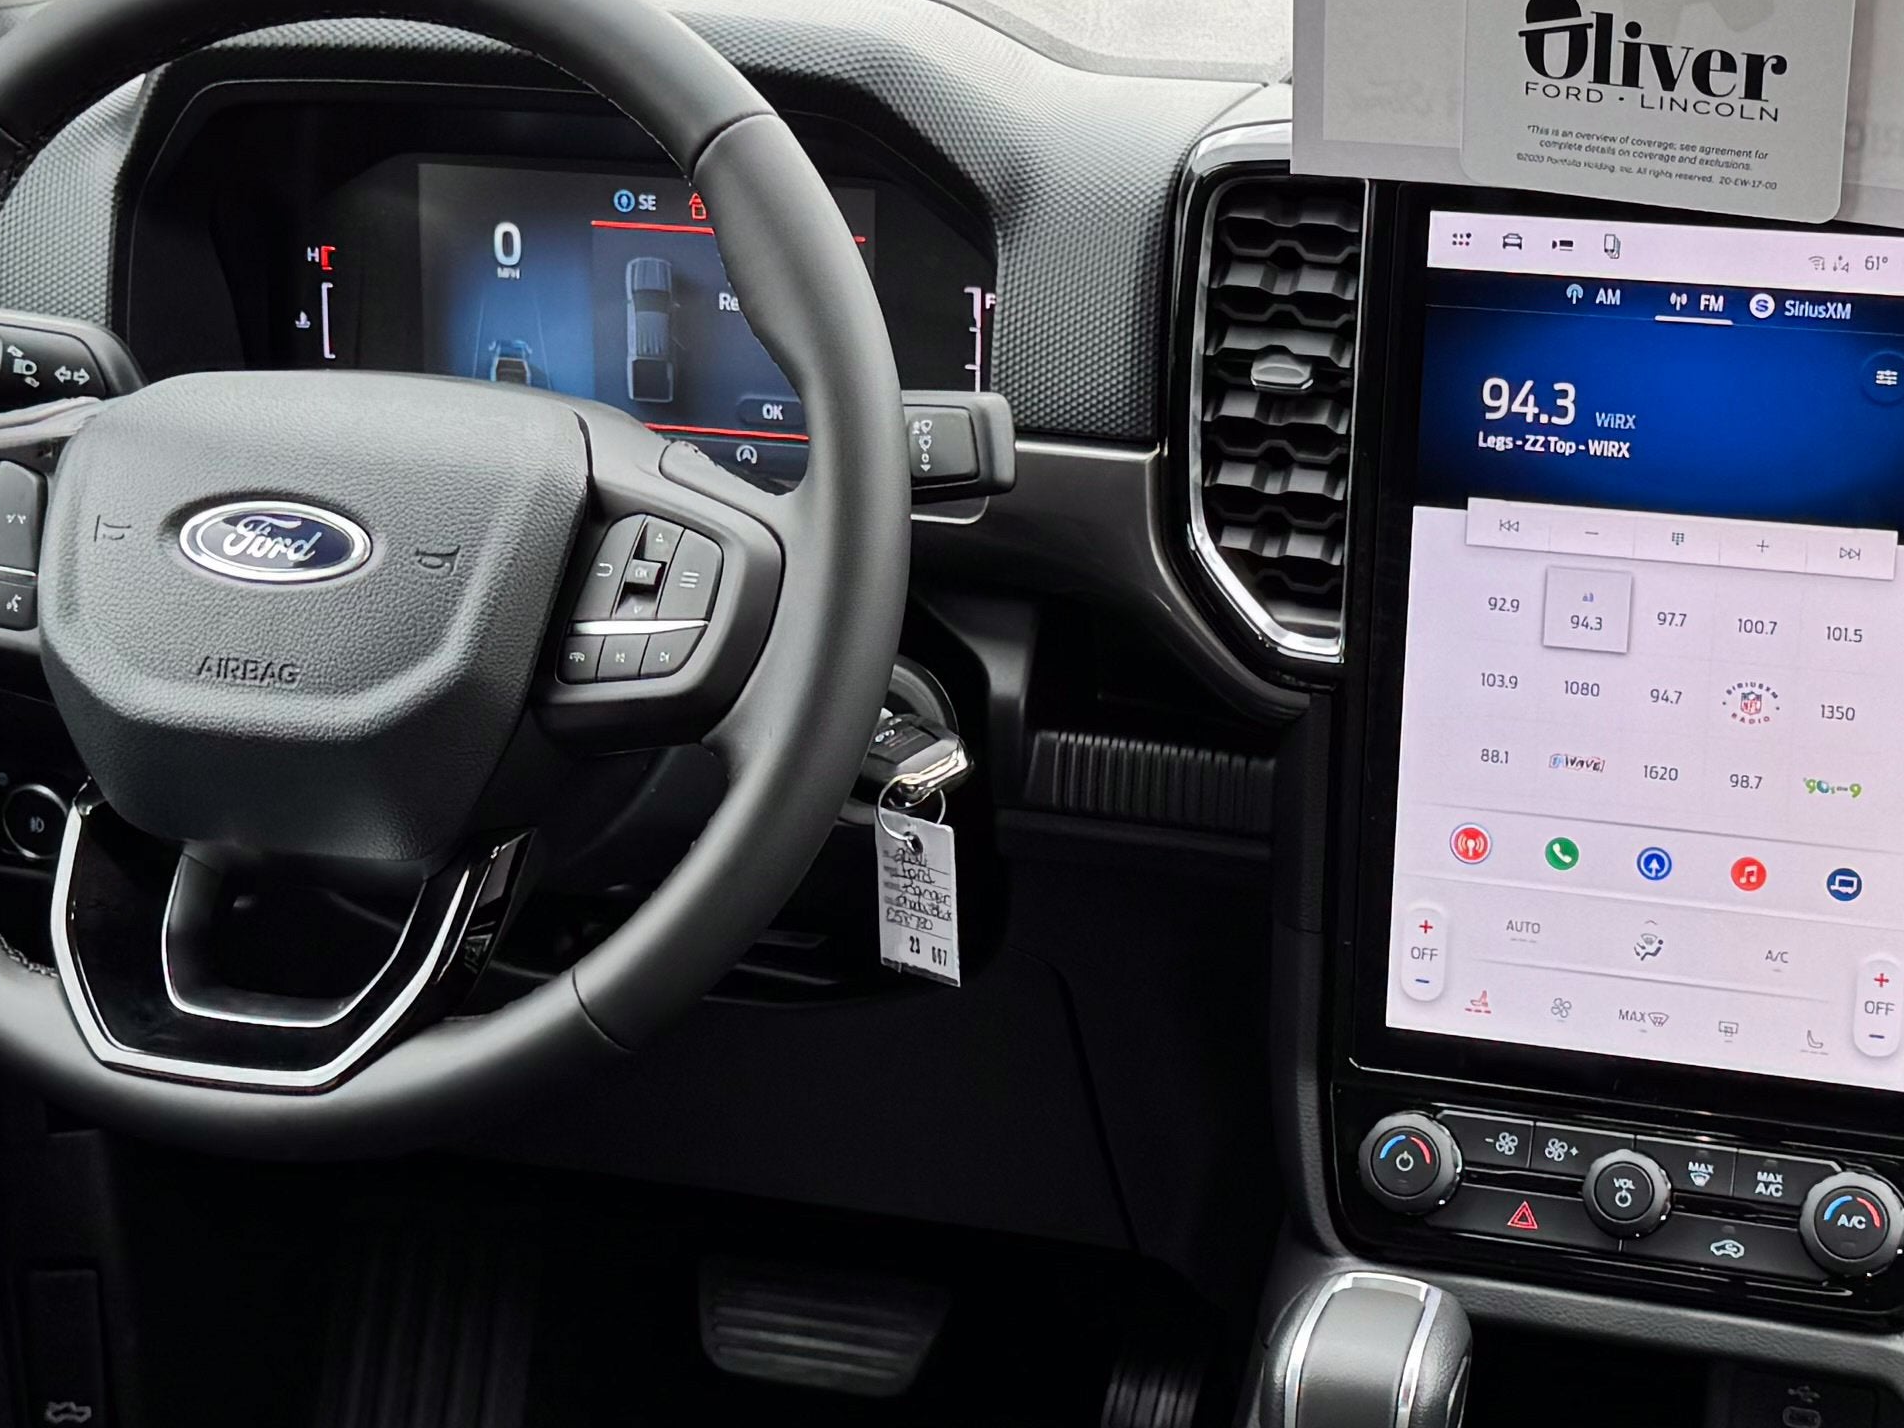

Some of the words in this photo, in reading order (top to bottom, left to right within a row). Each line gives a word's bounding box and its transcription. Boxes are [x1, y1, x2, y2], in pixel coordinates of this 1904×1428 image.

[1525, 81, 1604, 104] FORD
[1640, 95, 1779, 122] LINCOLN
[1539, 139, 1583, 152] complete
[1584, 142, 1616, 156] details
[1618, 148, 1631, 157] on
[1632, 150, 1676, 163] coverage
[1678, 154, 1696, 166] and
[1561, 129, 1574, 139] an
[1575, 131, 1618, 144] overview
[1619, 135, 1629, 144] of
[1698, 146, 1752, 159] agreement
[1754, 150, 1769, 160] for
[638, 195, 657, 211] SE
[493, 221, 523, 267] 0
[307, 246, 319, 262] H
[1863, 254, 1889, 273] 61°
[718, 293, 741, 312] Re
[1595, 287, 1621, 307] AM
[1699, 294, 1725, 314] FM
[1783, 299, 1852, 321] SiriusXM
[1481, 376, 1577, 426] 94.3
[762, 403, 784, 422] OK
[1595, 410, 1637, 431] WIRX
[1477, 430, 1513, 452] Legs
[1524, 434, 1546, 453] ZZ
[1547, 436, 1576, 457] Top
[1587, 438, 1631, 459] WIRX
[222, 515, 323, 562] Ford
[1487, 596, 1521, 614] 92.9
[1570, 614, 1604, 632] 94.3
[1656, 611, 1688, 629] 97.7
[1737, 618, 1779, 637] 100.7
[1825, 625, 1864, 645] 101.5
[196, 656, 300, 684] AIRBAG
[1480, 672, 1519, 691] 103.9
[1563, 680, 1601, 698] 1080
[1649, 688, 1683, 707] 94.7
[1820, 704, 1856, 722] 1350
[1480, 749, 1510, 766] 88.1
[1642, 763, 1679, 783] 1620
[1729, 773, 1763, 790] 98.7
[1506, 918, 1541, 935] AUTO
[1409, 945, 1439, 962] OFF
[1764, 949, 1790, 965] A/C
[1618, 1008, 1647, 1024] MAX
[1863, 1000, 1894, 1017] OFF
[1687, 1160, 1715, 1175] MAX
[1613, 1177, 1635, 1191] VOL
[1756, 1170, 1784, 1185] MAX
[1754, 1182, 1783, 1198] A/C
[1836, 1212, 1867, 1231] A/C
